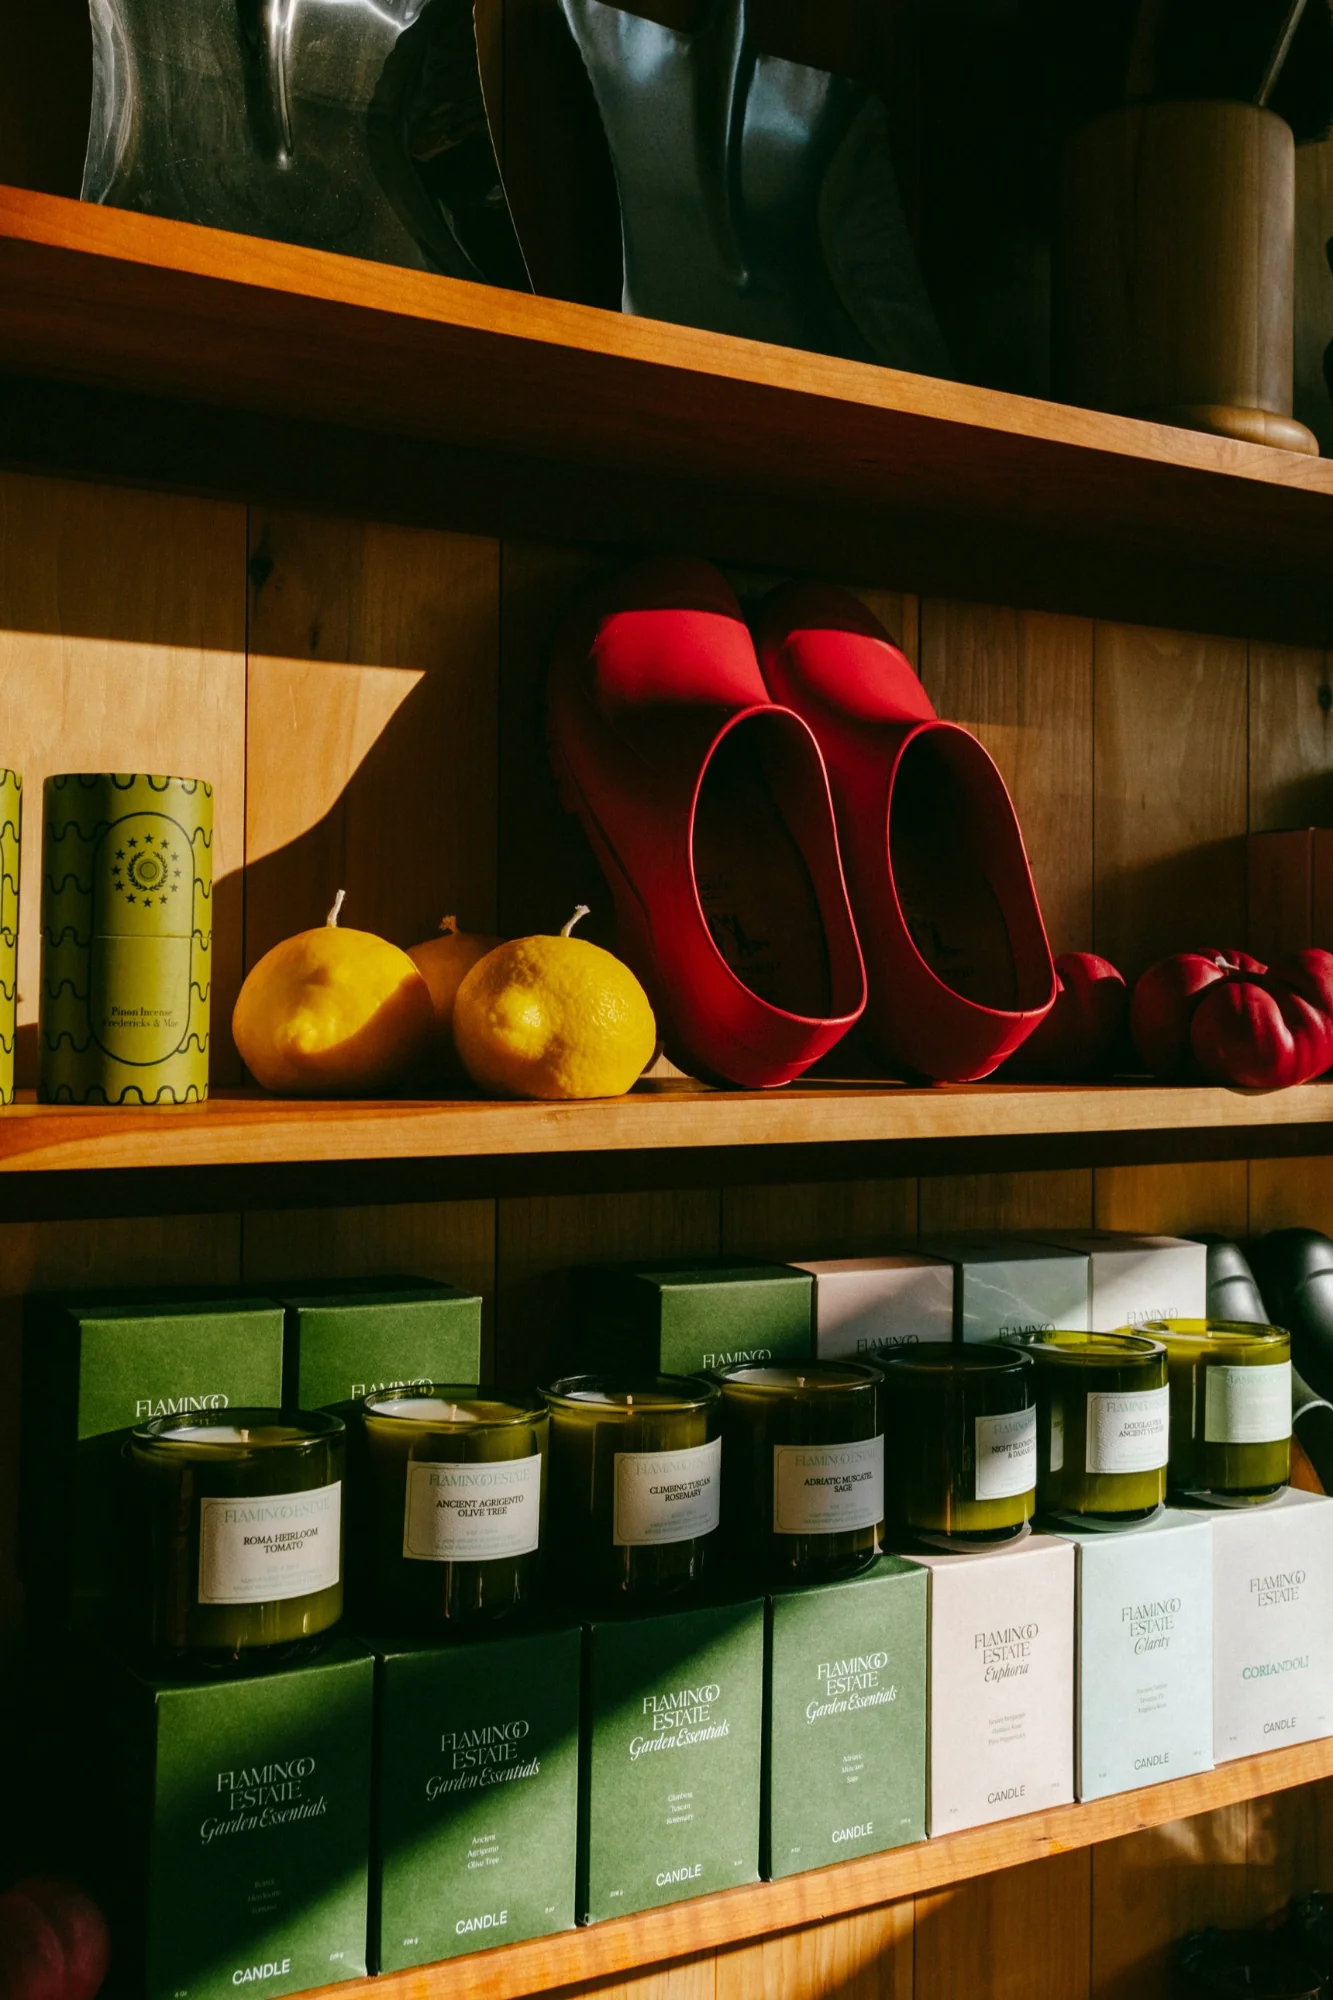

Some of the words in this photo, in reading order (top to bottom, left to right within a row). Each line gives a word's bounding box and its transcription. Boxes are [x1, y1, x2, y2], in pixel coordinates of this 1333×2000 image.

[111, 1006, 138, 1016] Pinon
[140, 1007, 173, 1017] Incense
[153, 1019, 160, 1028] &
[703, 1349, 772, 1369] FLAMINGO
[136, 1393, 229, 1418] FLAMINGO
[991, 1443, 1012, 1455] NIGHT
[429, 1472, 493, 1487] FLAMINGO
[650, 1483, 687, 1495] CLIMBING
[688, 1476, 711, 1489] TUSCAN
[804, 1477, 841, 1486] ADRIATIC
[842, 1471, 873, 1484] MUSCATEL
[834, 1484, 853, 1493] SAGE
[436, 1500, 477, 1508] ANCIENT
[479, 1494, 524, 1507] AGRIGENTO
[665, 1488, 701, 1502] ROSEMARY
[458, 1509, 485, 1517] OLIVE
[487, 1507, 508, 1516] TREE
[243, 1536, 273, 1546] ROMA
[274, 1527, 318, 1543] HEIRLOOM
[263, 1540, 304, 1554] TOMATO
[1250, 1569, 1306, 1592] FLAMINGO
[1258, 1586, 1300, 1607] ESTATE
[1122, 1598, 1182, 1622] FLAMINGO
[974, 1623, 1039, 1649] FLAMINGO
[1130, 1615, 1174, 1636] ESTATE
[983, 1641, 1031, 1664] ESTATE
[1133, 1633, 1171, 1656] Clarity
[818, 1651, 888, 1680] FLAMINGO
[984, 1659, 1029, 1683] Euphoria
[1242, 1655, 1309, 1680] CORIANDOLI
[827, 1671, 878, 1696] ESTATE
[643, 1683, 720, 1714] FLAMINGO
[806, 1697, 848, 1724] Garden
[848, 1685, 897, 1710] Essentials
[653, 1704, 710, 1732] ESTATE
[1263, 1716, 1297, 1734] CANDLE
[441, 1719, 529, 1752] FLAMINGO
[630, 1732, 676, 1761] Garden
[677, 1719, 730, 1747] Essentials
[453, 1741, 518, 1770] ESTATE
[1134, 1752, 1170, 1770] CANDLE
[217, 1757, 315, 1792] FLAMINGO
[426, 1772, 478, 1801] Garden
[479, 1756, 540, 1786] Essentials
[230, 1780, 302, 1811] ESTATE
[988, 1784, 1026, 1804] CANDLE
[200, 1812, 258, 1845] Garden
[260, 1796, 328, 1828] Essentials
[832, 1822, 873, 1843] CANDLE
[486, 1858, 500, 1866] Tree
[656, 1863, 702, 1886] CANDLE
[455, 1910, 508, 1934] CANDLE
[232, 1958, 291, 1985] CANDLE
